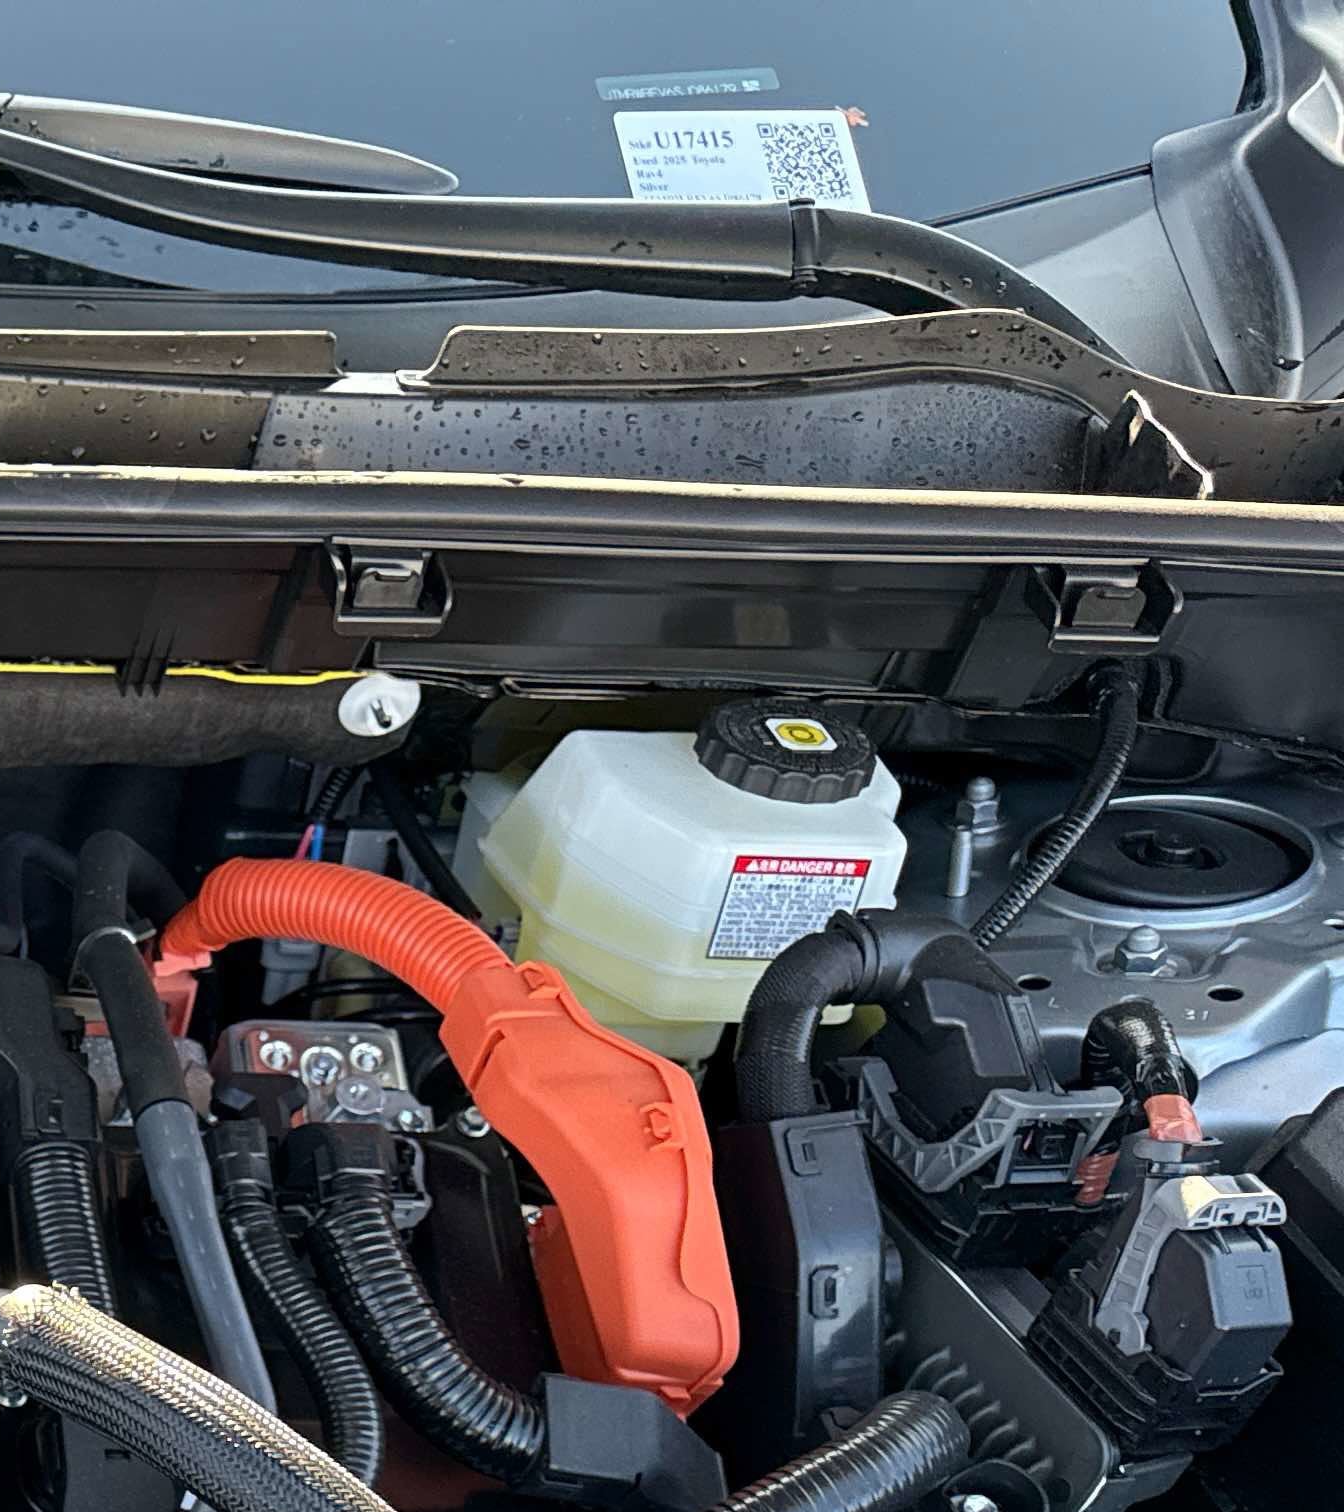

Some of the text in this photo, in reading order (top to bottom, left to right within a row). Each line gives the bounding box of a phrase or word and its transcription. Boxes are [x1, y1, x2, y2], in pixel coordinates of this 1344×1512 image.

[654, 130, 734, 149] U17415
[633, 156, 658, 165] Used
[692, 155, 726, 167] Toyota
[637, 169, 663, 178] Rav4
[640, 182, 669, 191] Silver
[779, 860, 834, 874] DANGER
